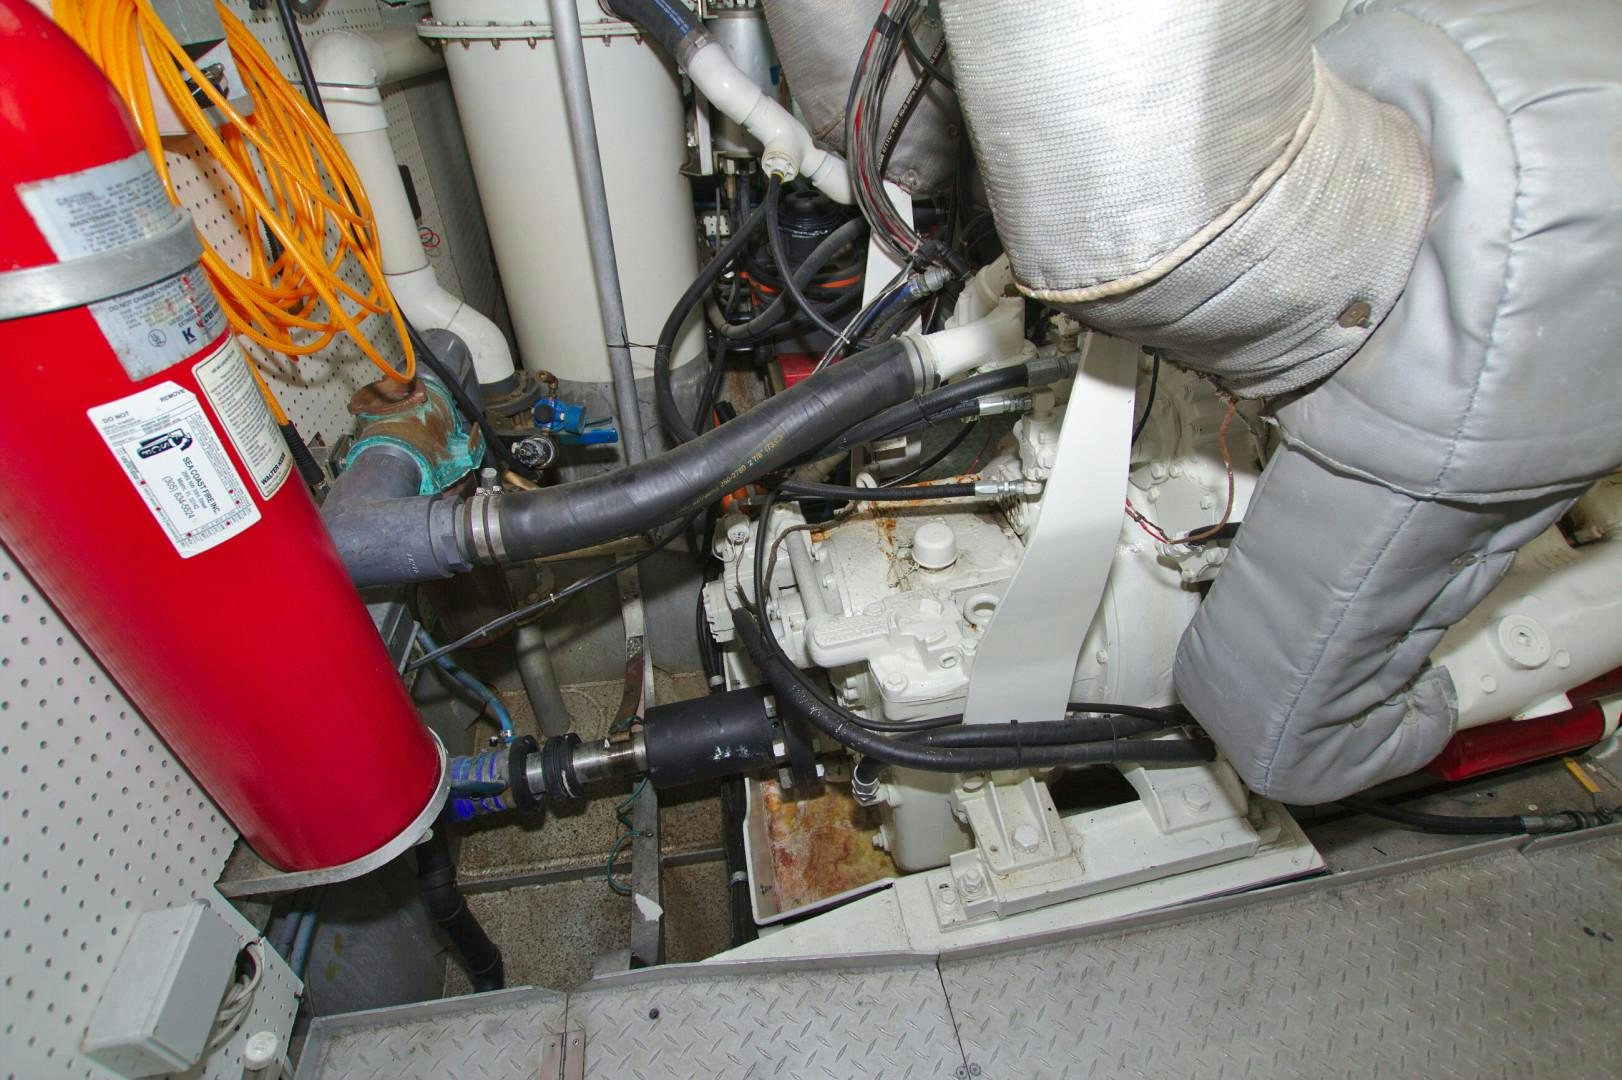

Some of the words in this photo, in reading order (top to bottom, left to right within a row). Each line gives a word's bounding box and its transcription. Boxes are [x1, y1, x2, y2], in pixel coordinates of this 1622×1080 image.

[102, 416, 113, 424] DO
[115, 411, 129, 419] NOT
[160, 389, 186, 402] REMOVE
[161, 474, 178, 493] (305)
[182, 456, 195, 470] SEA
[189, 468, 206, 490] COAST
[201, 488, 214, 503] FIRE
[260, 463, 279, 486] WALTER
